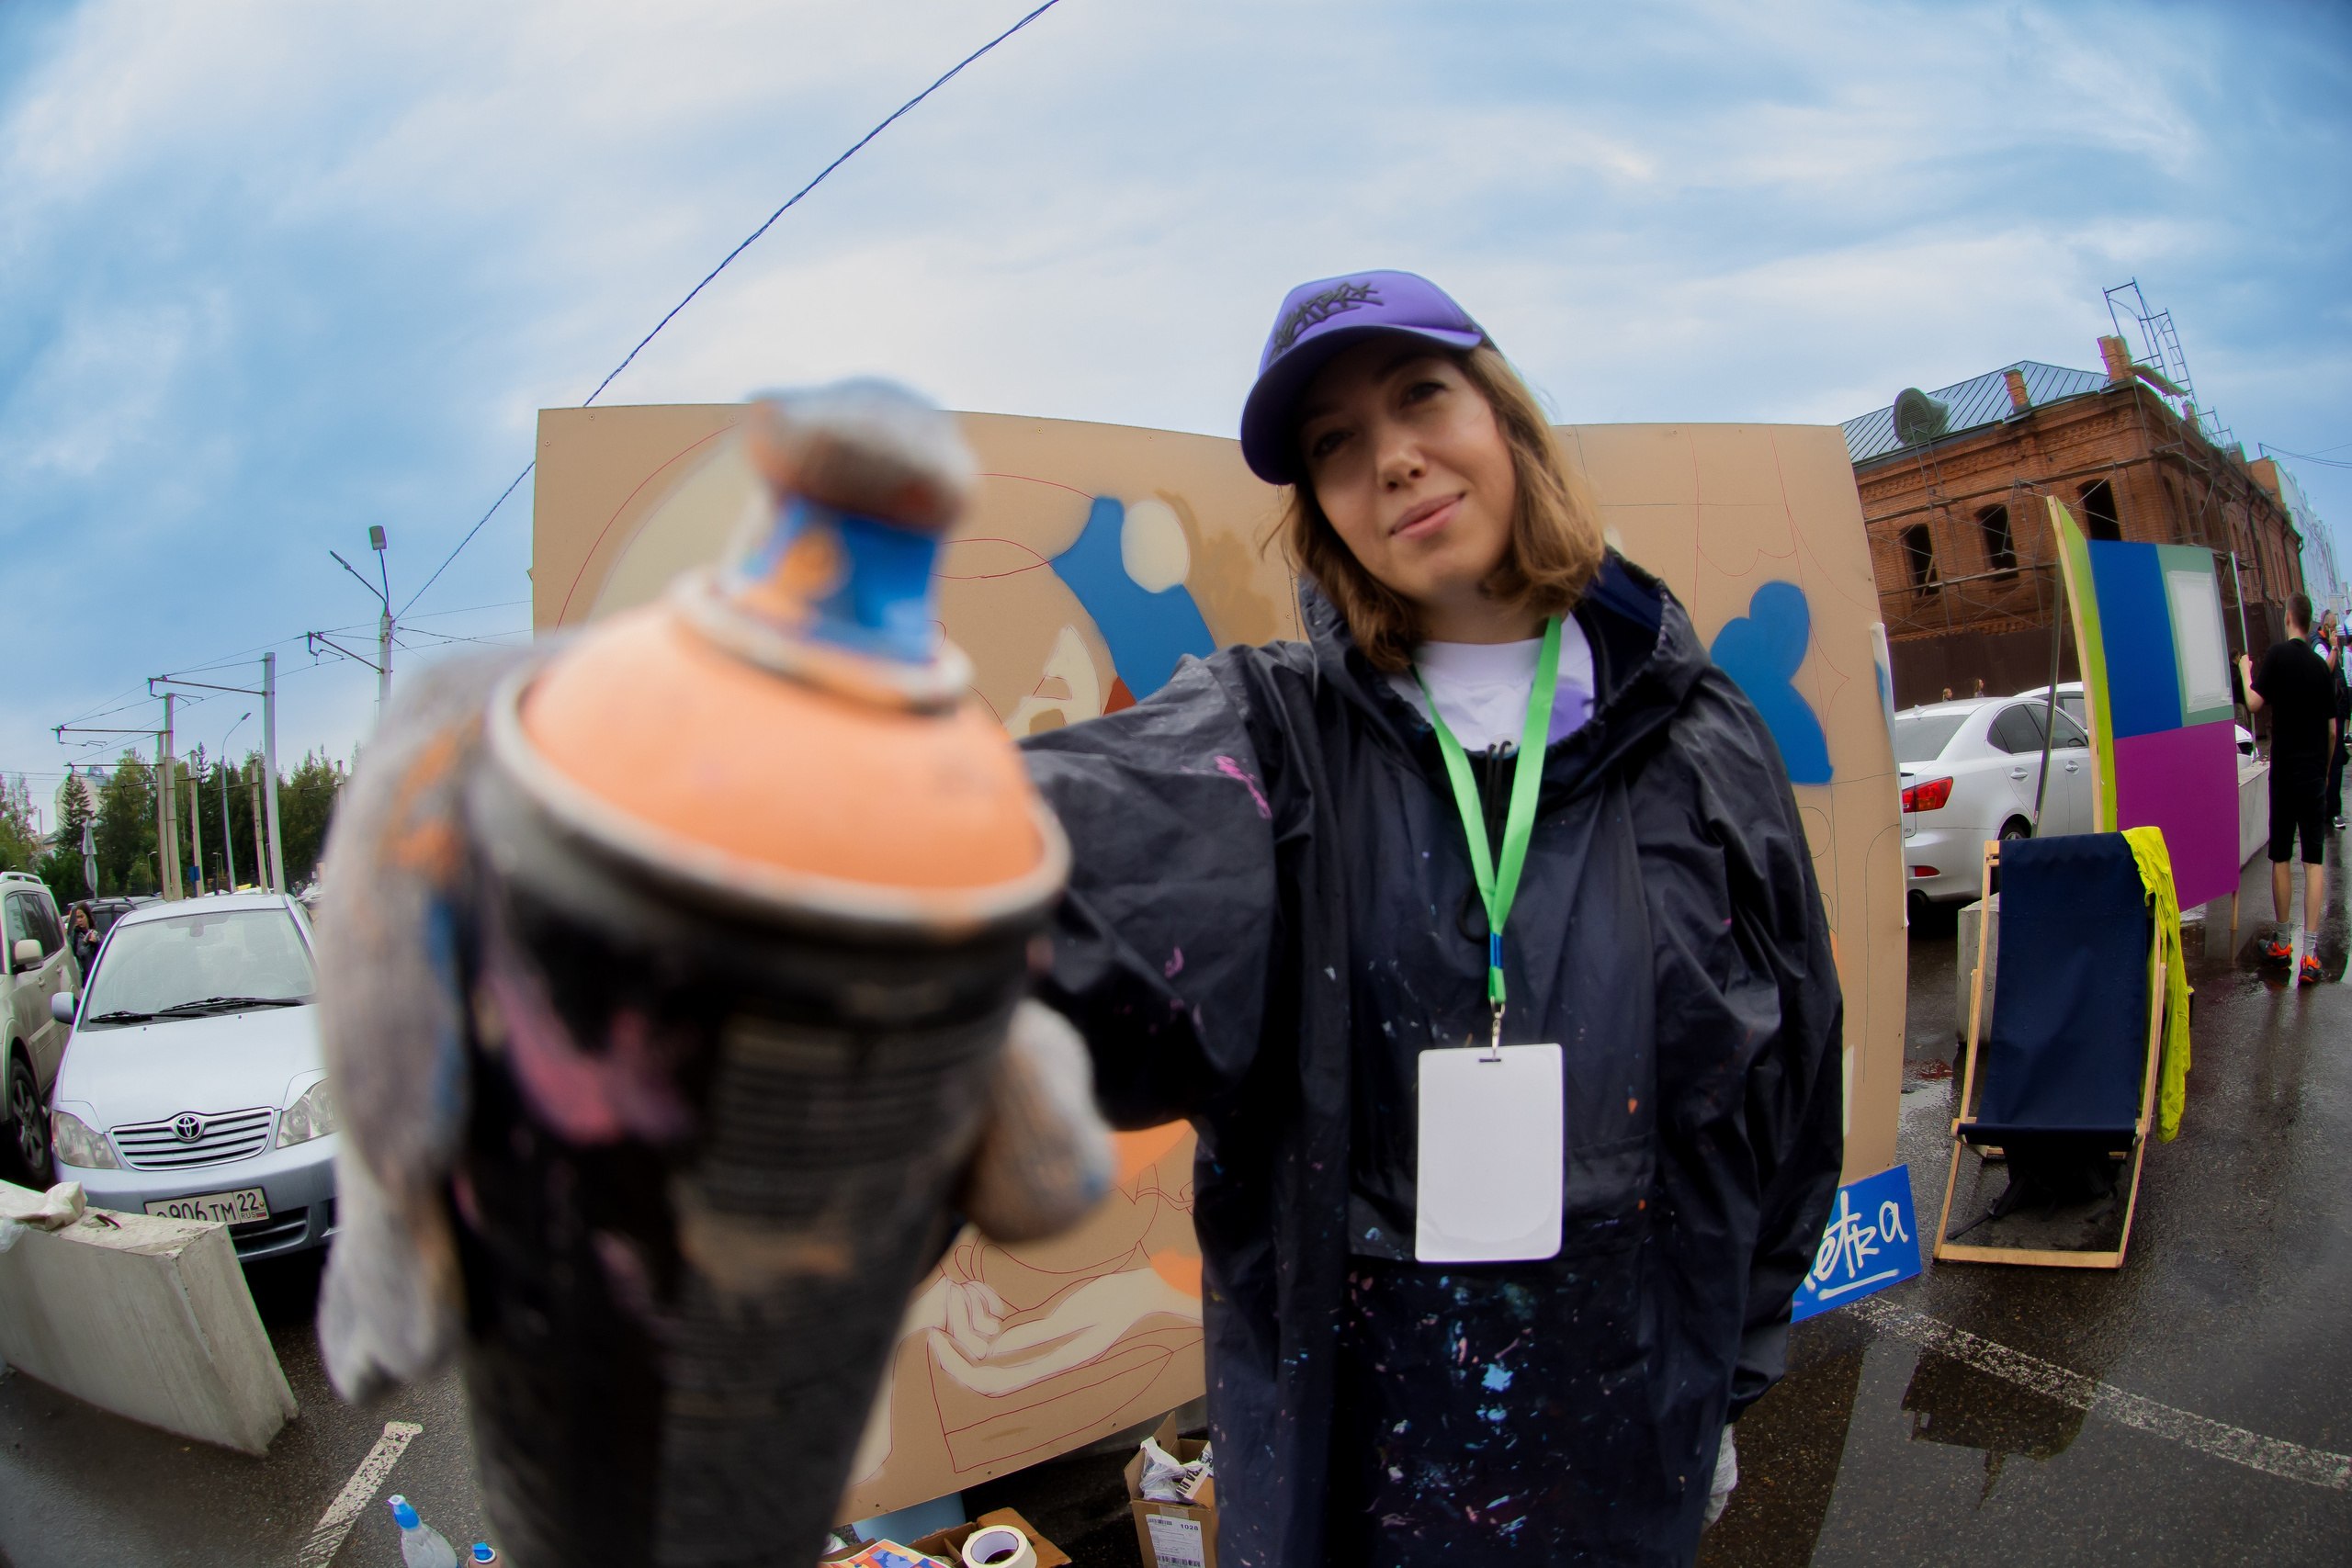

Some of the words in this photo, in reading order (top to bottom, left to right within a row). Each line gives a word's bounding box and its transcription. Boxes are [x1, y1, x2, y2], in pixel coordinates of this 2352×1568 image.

[237, 1192, 259, 1212] 22
[241, 1211, 257, 1220] RUS
[1181, 1523, 1199, 1531] 1028
